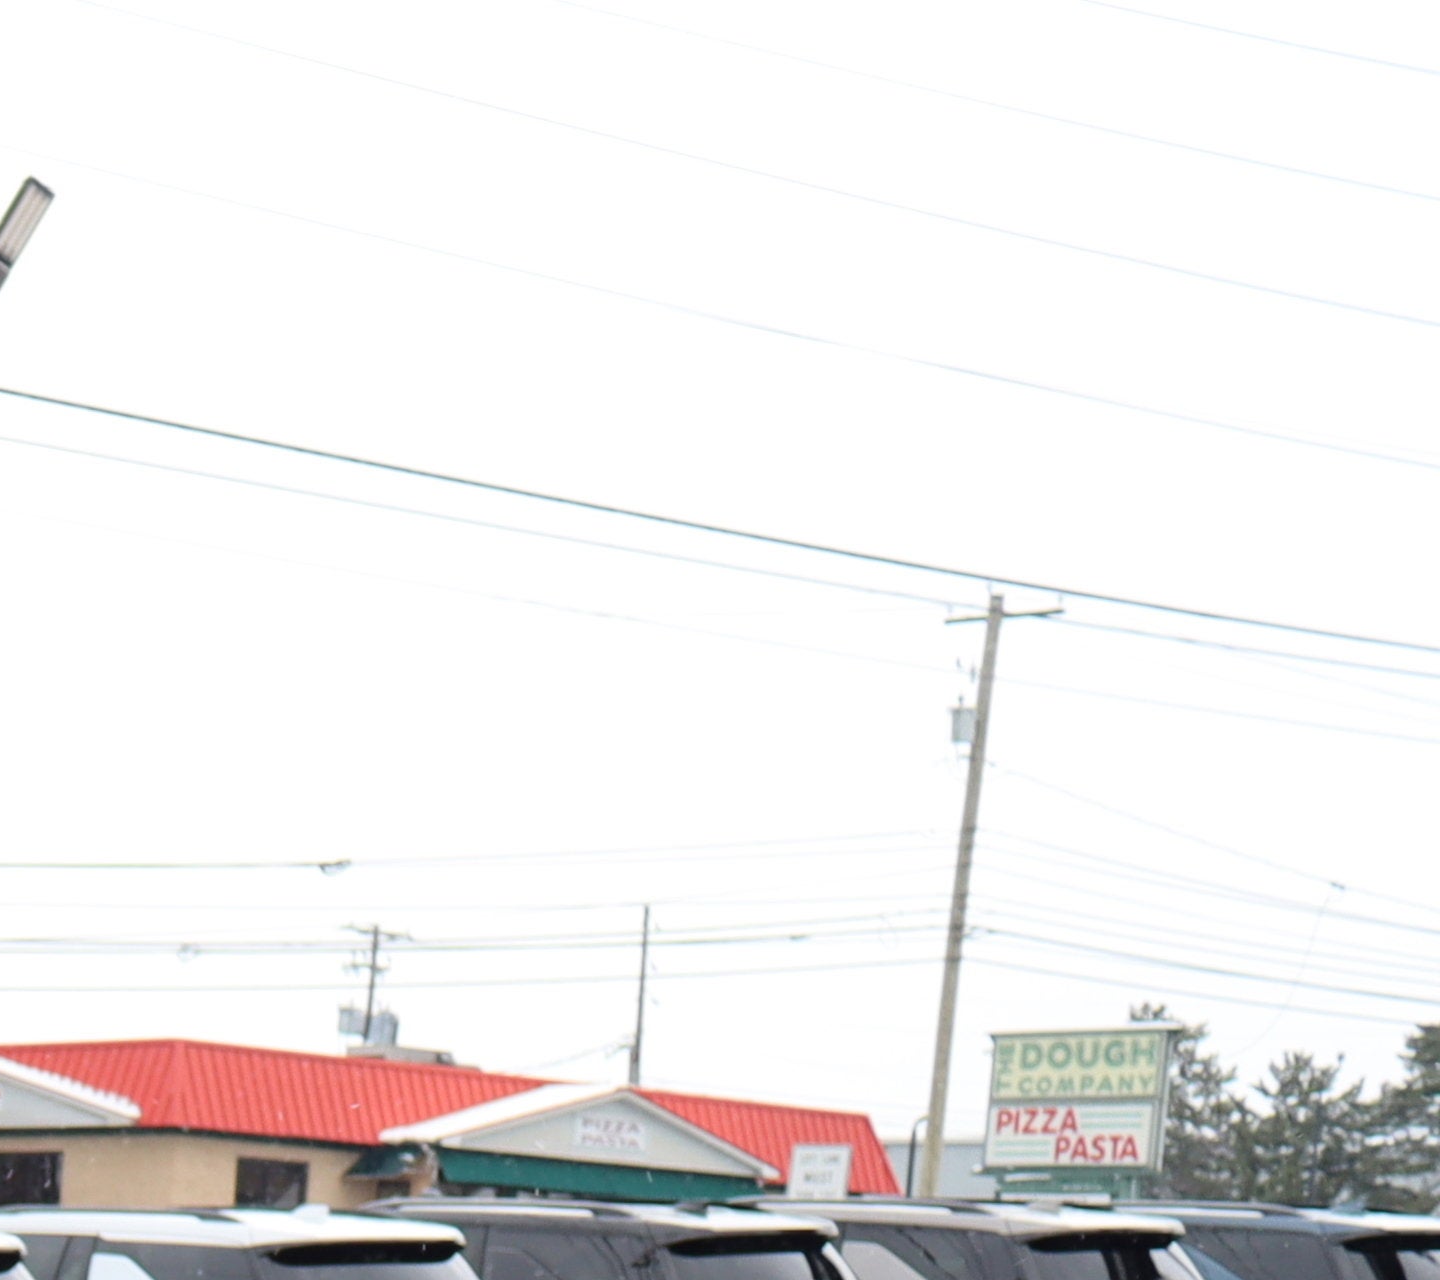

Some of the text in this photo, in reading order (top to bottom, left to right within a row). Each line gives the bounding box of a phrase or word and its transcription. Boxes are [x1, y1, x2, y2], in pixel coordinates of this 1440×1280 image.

[1020, 1039, 1156, 1070] DOUGH
[1018, 1074, 1154, 1095] COMPANY
[996, 1106, 1078, 1134] PIZZA
[1053, 1135, 1138, 1163] PASTA
